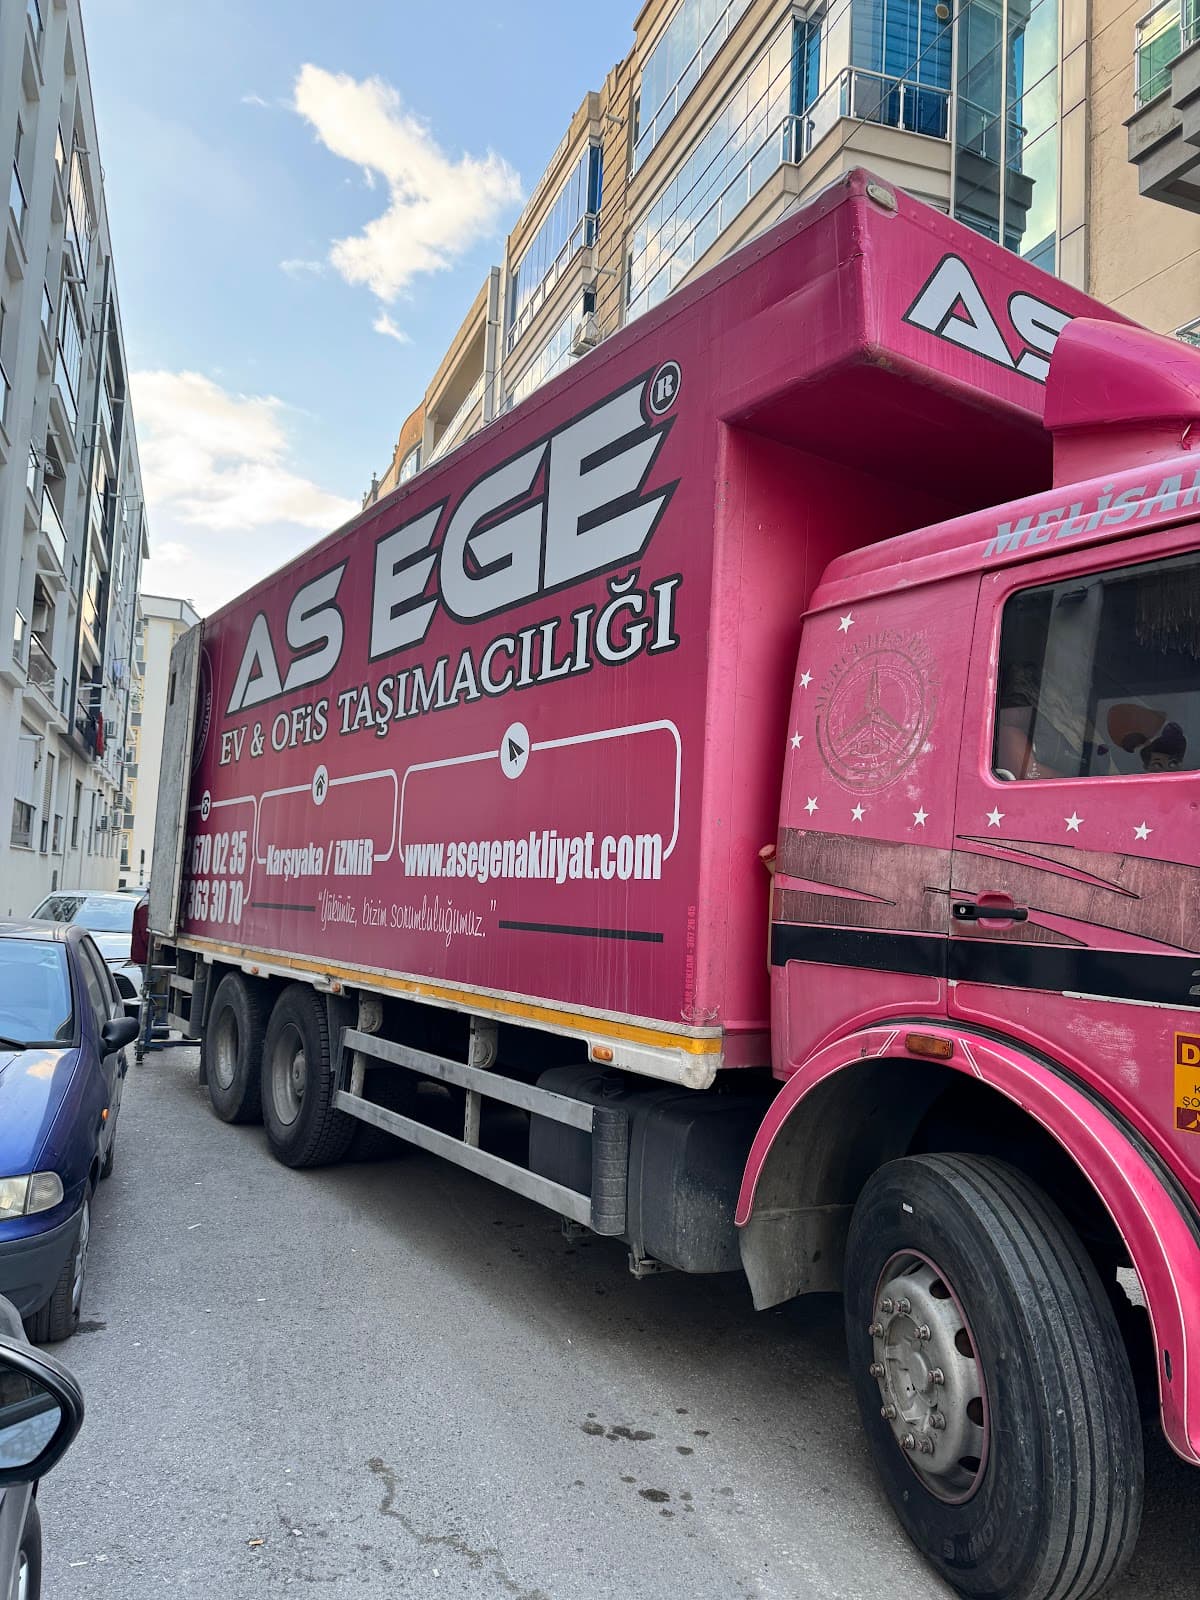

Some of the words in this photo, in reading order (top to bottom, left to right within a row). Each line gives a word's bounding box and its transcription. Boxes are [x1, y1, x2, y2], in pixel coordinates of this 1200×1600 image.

[901, 252, 1074, 386] AS
[226, 560, 348, 715] AS
[369, 374, 677, 662] EGE
[219, 726, 247, 765] EV
[250, 722, 264, 757] &
[338, 571, 680, 737] TAŞIMACILIĞI
[191, 833, 212, 875] 670
[212, 831, 229, 875] 02
[229, 830, 248, 875] 35
[266, 842, 324, 882] Karşıyaka
[324, 840, 334, 876] /
[403, 830, 662, 884] www.asegenakliyat.com
[188, 879, 210, 921] 363
[210, 879, 227, 923] 30
[227, 880, 244, 925] 70
[362, 896, 388, 927] bizim
